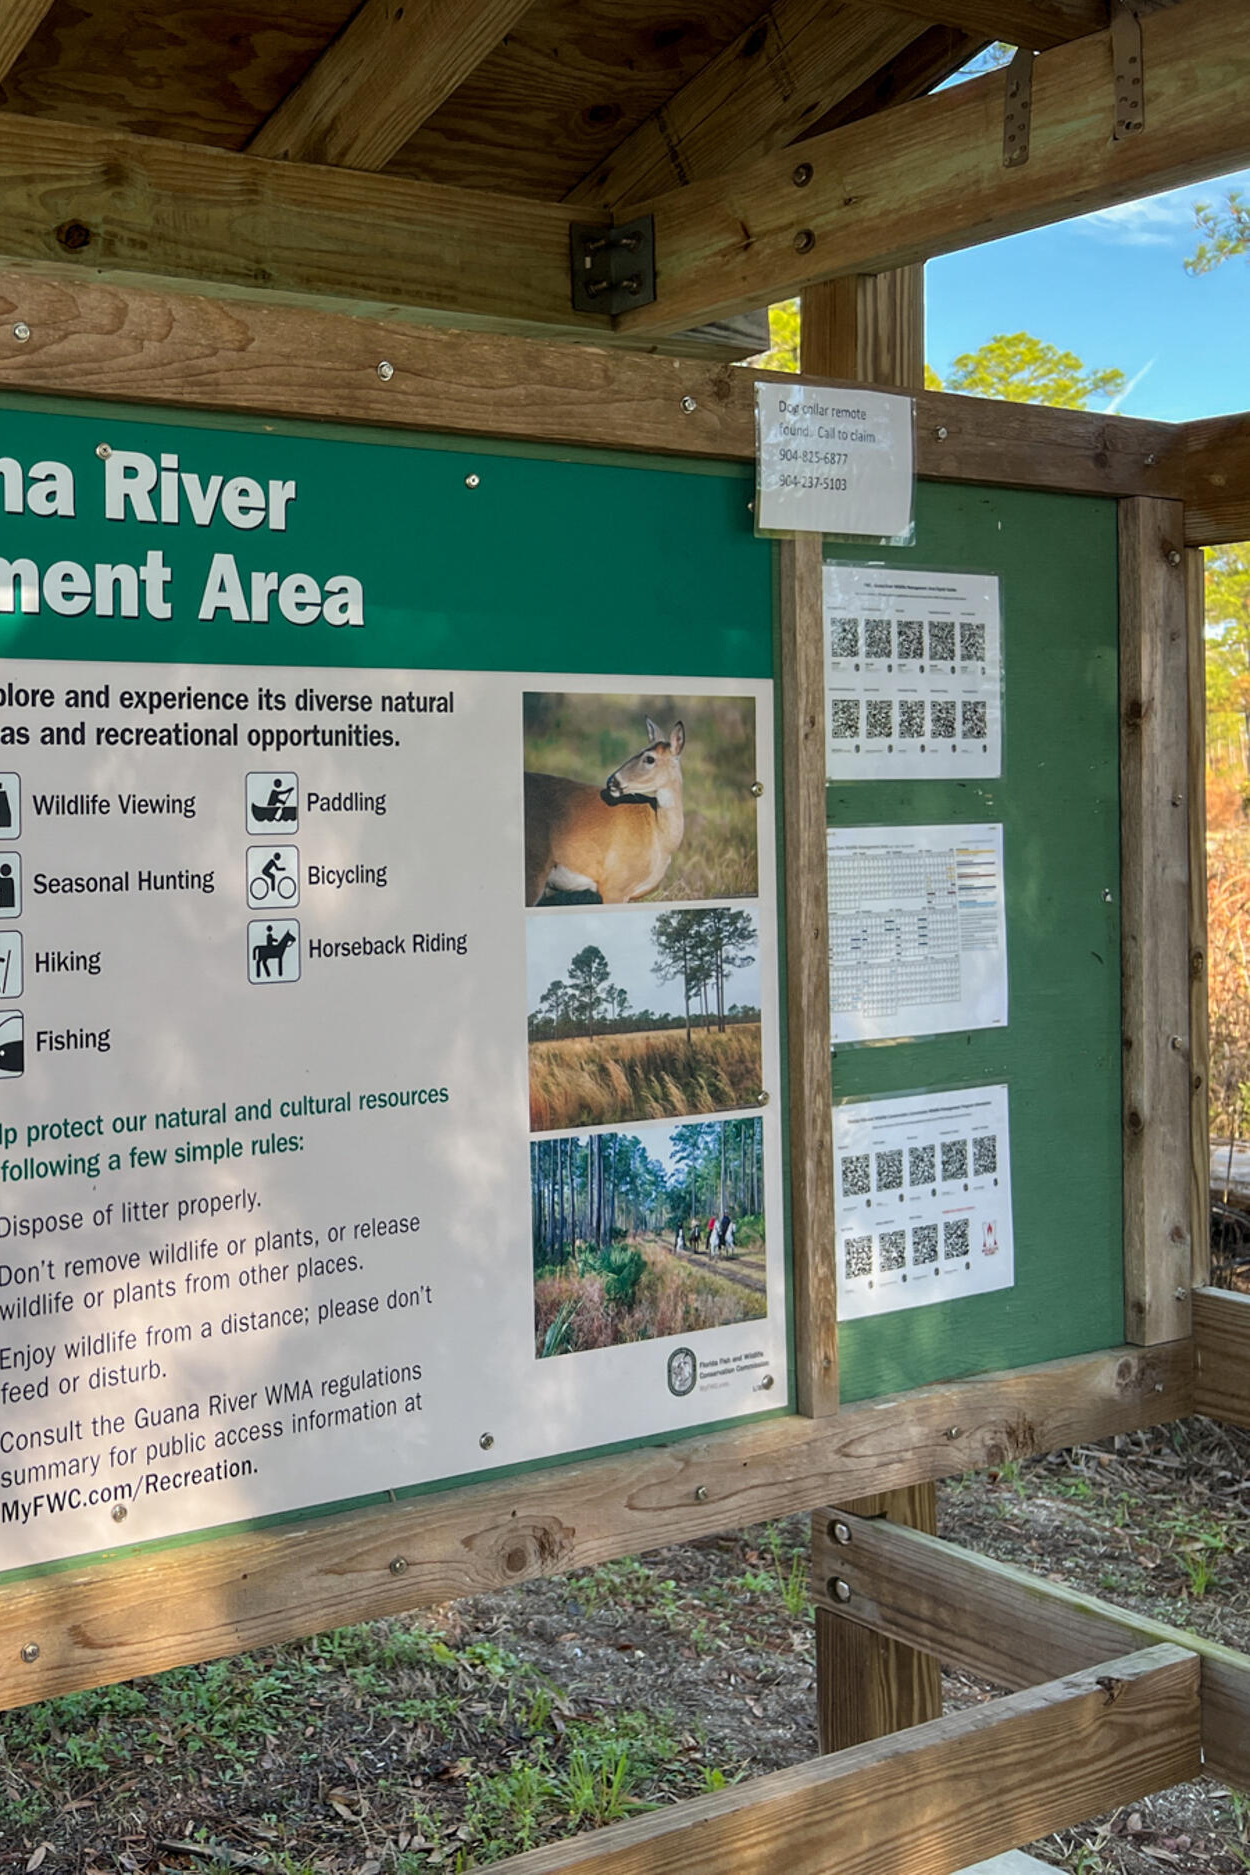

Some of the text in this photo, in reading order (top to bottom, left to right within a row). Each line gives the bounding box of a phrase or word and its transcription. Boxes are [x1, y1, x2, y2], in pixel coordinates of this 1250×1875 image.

[831, 406, 867, 420] remote
[817, 426, 835, 439] Call
[838, 428, 848, 441] to
[850, 429, 876, 443] claim
[104, 449, 296, 530] River
[198, 554, 364, 625] Area
[65, 685, 109, 708] and
[120, 686, 248, 714] experience
[259, 688, 286, 710] its
[295, 689, 372, 711] diverse
[382, 692, 453, 712] natural
[40, 722, 85, 745] and
[97, 723, 237, 746] recreational
[248, 724, 399, 751] opportunities.
[33, 794, 195, 818] Wildlife Viewing
[308, 792, 386, 815] Paddling
[34, 870, 214, 894] Seasonal Hunting
[309, 865, 387, 888] Bicycling
[36, 951, 101, 975] Hiking
[310, 933, 467, 958] Horseback Riding
[37, 1028, 110, 1052] Fishing
[27, 1115, 103, 1147] protect
[113, 1115, 146, 1133] our
[156, 1103, 226, 1129] natural
[235, 1099, 271, 1121] and
[280, 1092, 350, 1117] cultural
[360, 1088, 448, 1110] resources
[1, 1154, 100, 1182] following
[109, 1154, 120, 1170] a
[129, 1147, 167, 1168] few
[175, 1138, 243, 1164] simple
[252, 1133, 303, 1155] rules:
[93, 1204, 113, 1226] of
[122, 1202, 169, 1223] litter
[178, 1189, 260, 1221] properly.
[65, 1253, 140, 1278] remove
[149, 1239, 218, 1266] wildlife
[227, 1239, 246, 1256] or
[255, 1229, 318, 1256] plants,
[328, 1226, 346, 1242] or
[354, 1217, 420, 1239] release
[0, 1256, 363, 1320] wildlife or plants from other places.
[0, 1344, 55, 1371] Enjoy
[64, 1330, 136, 1359] wildlife
[146, 1325, 191, 1346] from
[201, 1322, 211, 1338] a
[222, 1307, 308, 1335] distance;
[319, 1297, 378, 1324] please
[1, 1360, 166, 1404] feed or disturb.
[0, 1365, 421, 1453] Consult the Guana River WMA regulations
[1, 1393, 422, 1488] summary for public access information at
[1, 1457, 258, 1524] MyFWC.com/Recreation.
